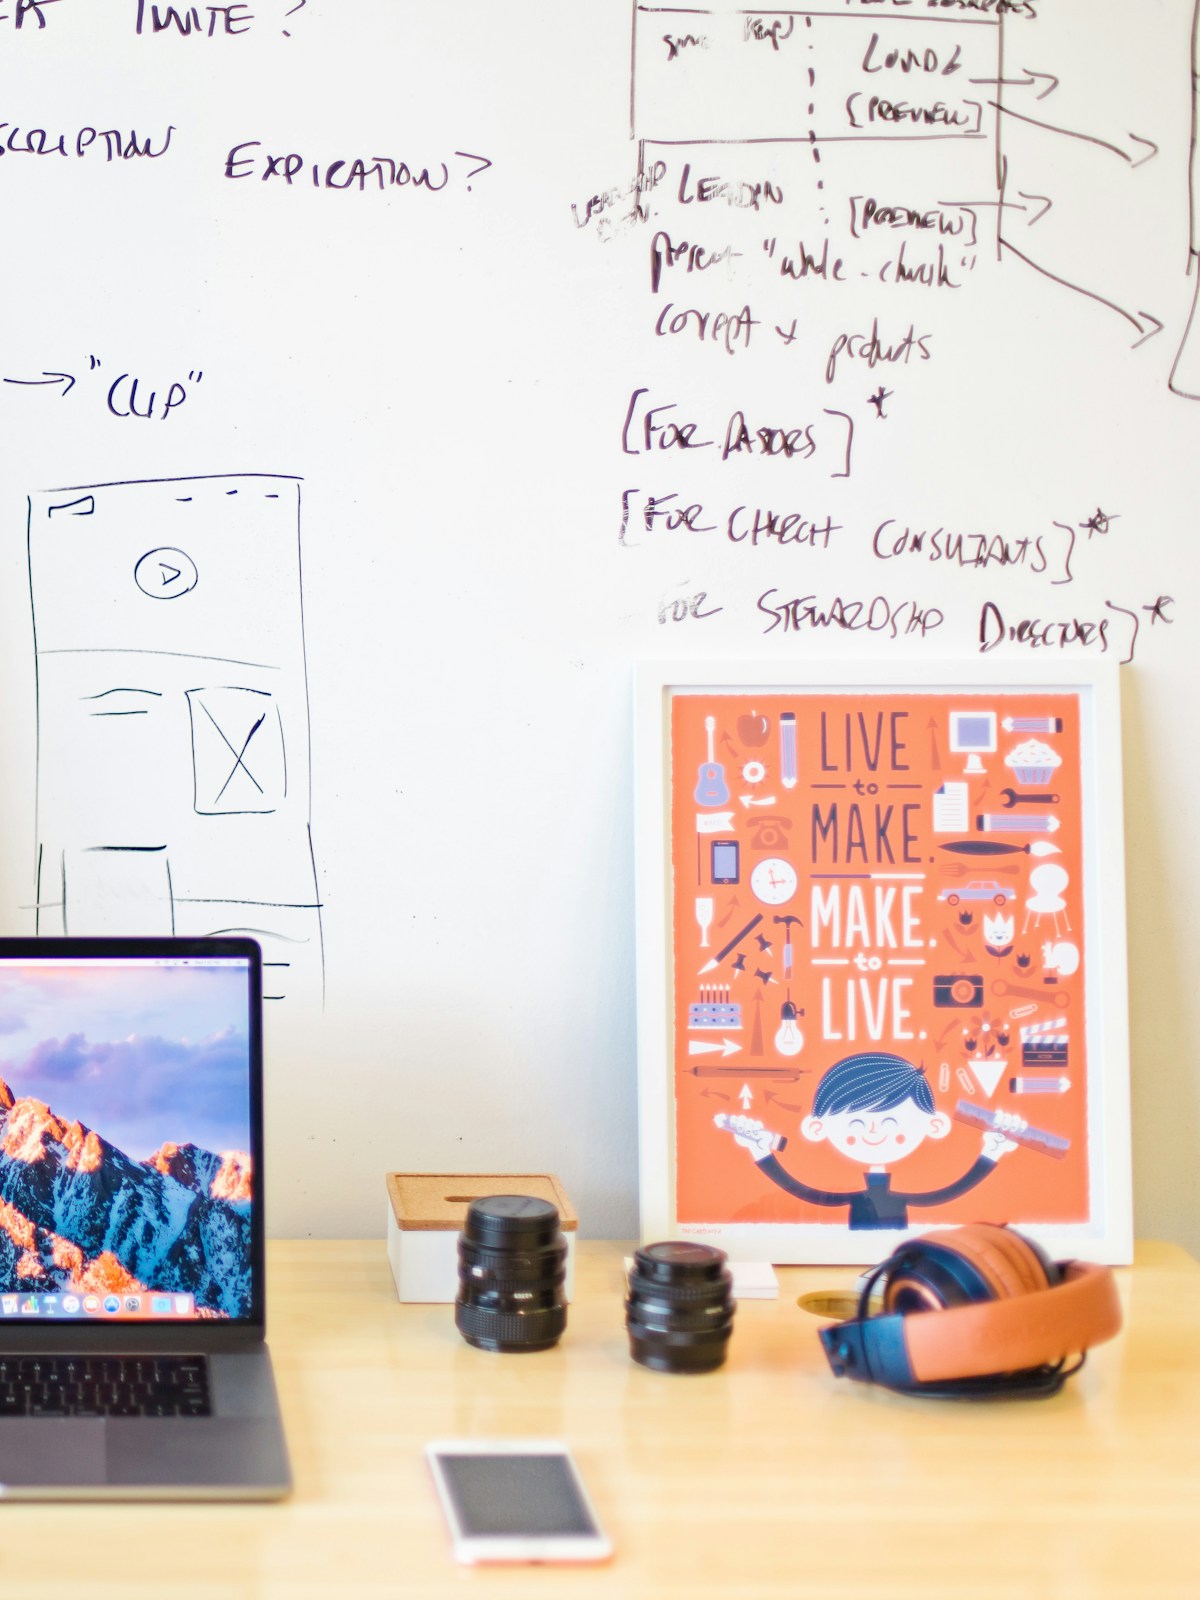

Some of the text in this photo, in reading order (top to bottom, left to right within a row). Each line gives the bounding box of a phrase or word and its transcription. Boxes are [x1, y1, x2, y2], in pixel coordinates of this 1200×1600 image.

[819, 710, 910, 773] LIVE
[852, 778, 880, 797] to
[809, 802, 937, 866] MAKE.
[809, 884, 938, 949] MAKE.
[853, 951, 883, 973] to
[821, 976, 929, 1042] LIVE.
